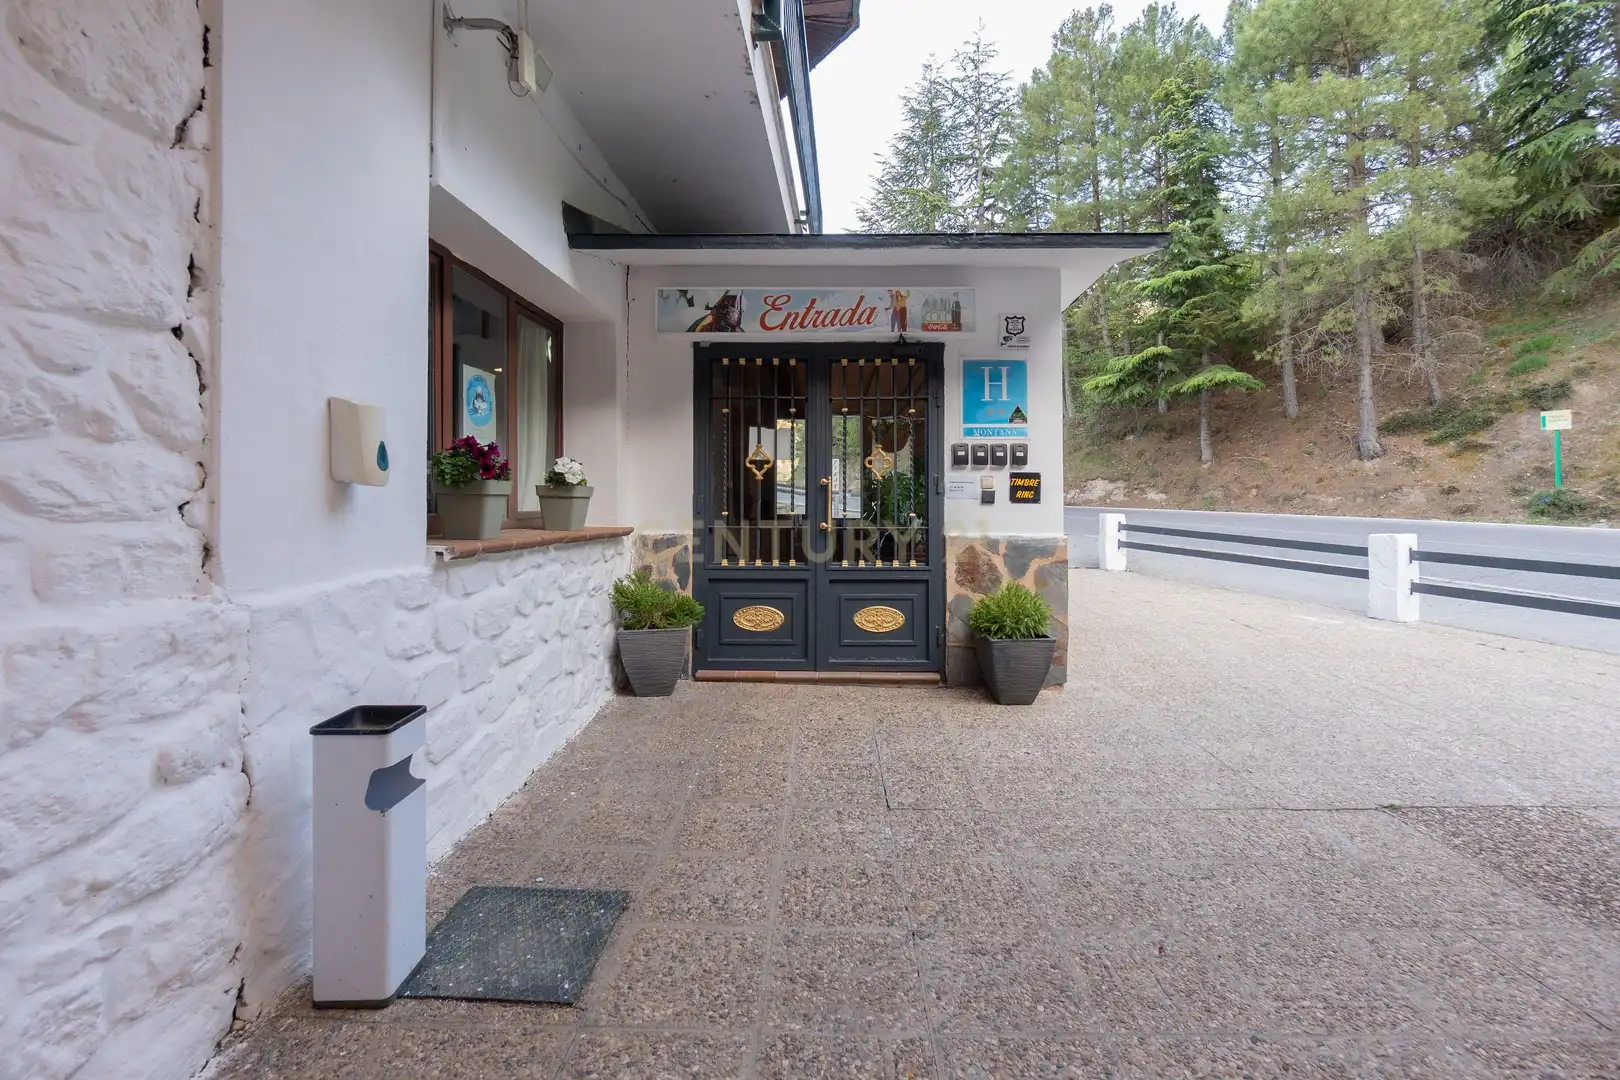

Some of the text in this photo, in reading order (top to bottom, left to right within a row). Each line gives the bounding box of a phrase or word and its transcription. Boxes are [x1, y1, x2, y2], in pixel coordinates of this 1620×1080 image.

[759, 294, 879, 331] Entrada
[981, 366, 1011, 401] H
[1010, 478, 1041, 487] TIMBRE
